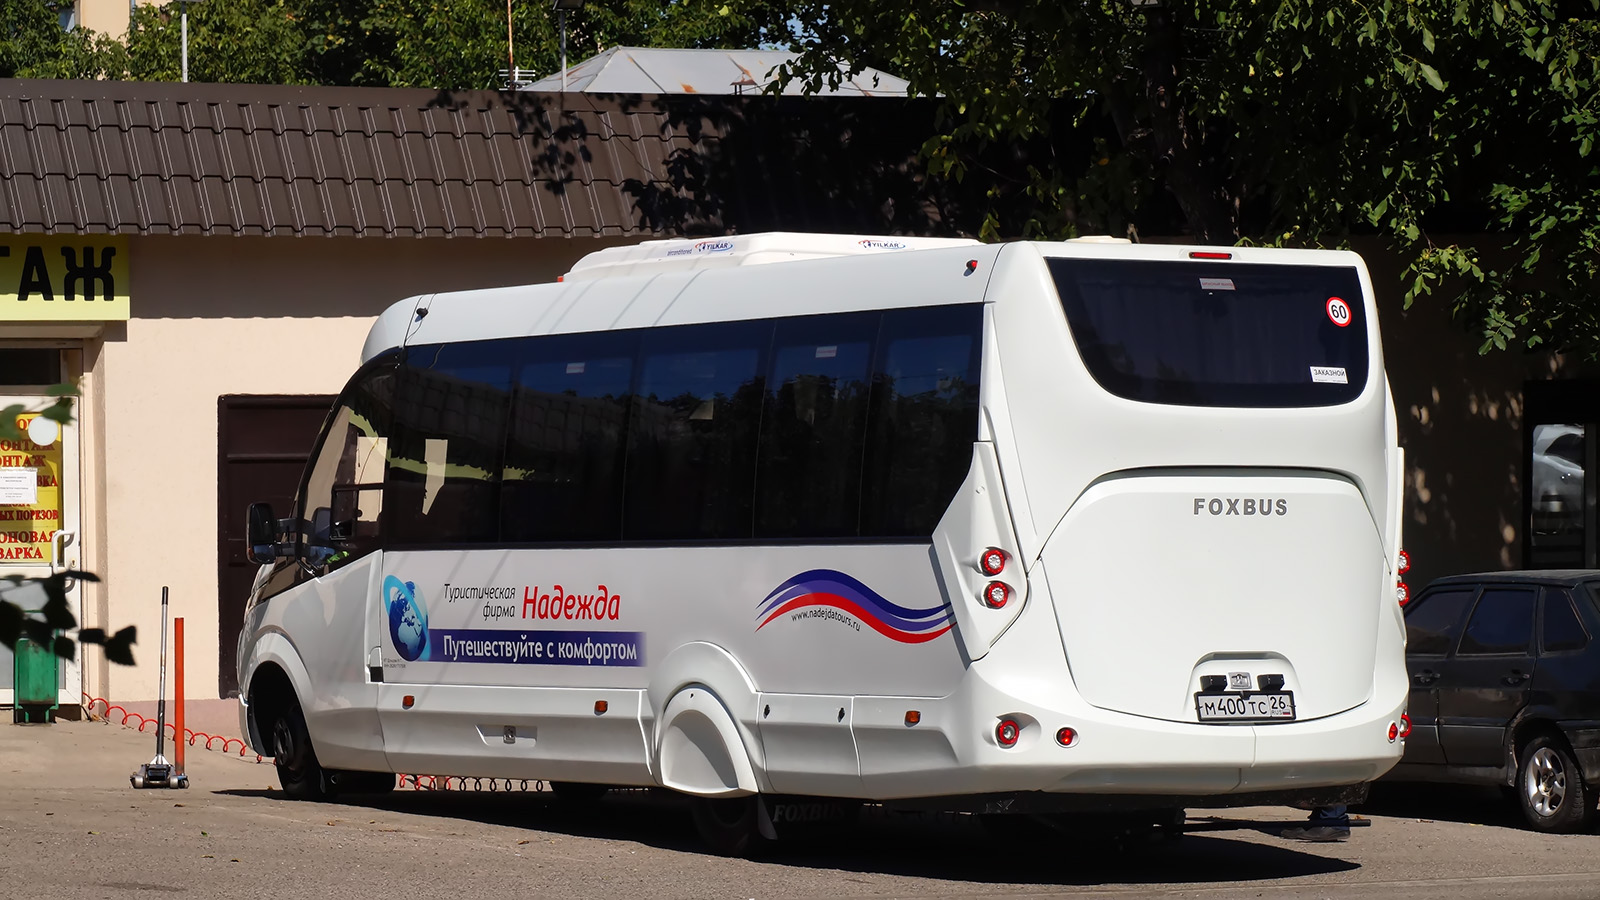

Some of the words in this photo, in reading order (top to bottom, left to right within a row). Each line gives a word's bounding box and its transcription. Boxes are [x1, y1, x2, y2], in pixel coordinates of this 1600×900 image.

[706, 242, 729, 250] YILKAR
[1331, 304, 1347, 320] 60
[1313, 368, 1346, 378] ЗАКАЗНОЙ
[0, 455, 46, 468] НТАЖ
[16, 509, 59, 521] ПОРЕЗОВ
[1193, 498, 1287, 516] FOXBUS
[443, 583, 516, 603] Туристическая
[522, 584, 621, 621] Надежда
[482, 602, 516, 622] фирма
[791, 607, 861, 632] www.nadejdatours.ru
[443, 634, 543, 662] Путешествуйте
[546, 640, 554, 656] с
[558, 637, 638, 665] комфортом
[1269, 696, 1286, 710] 26
